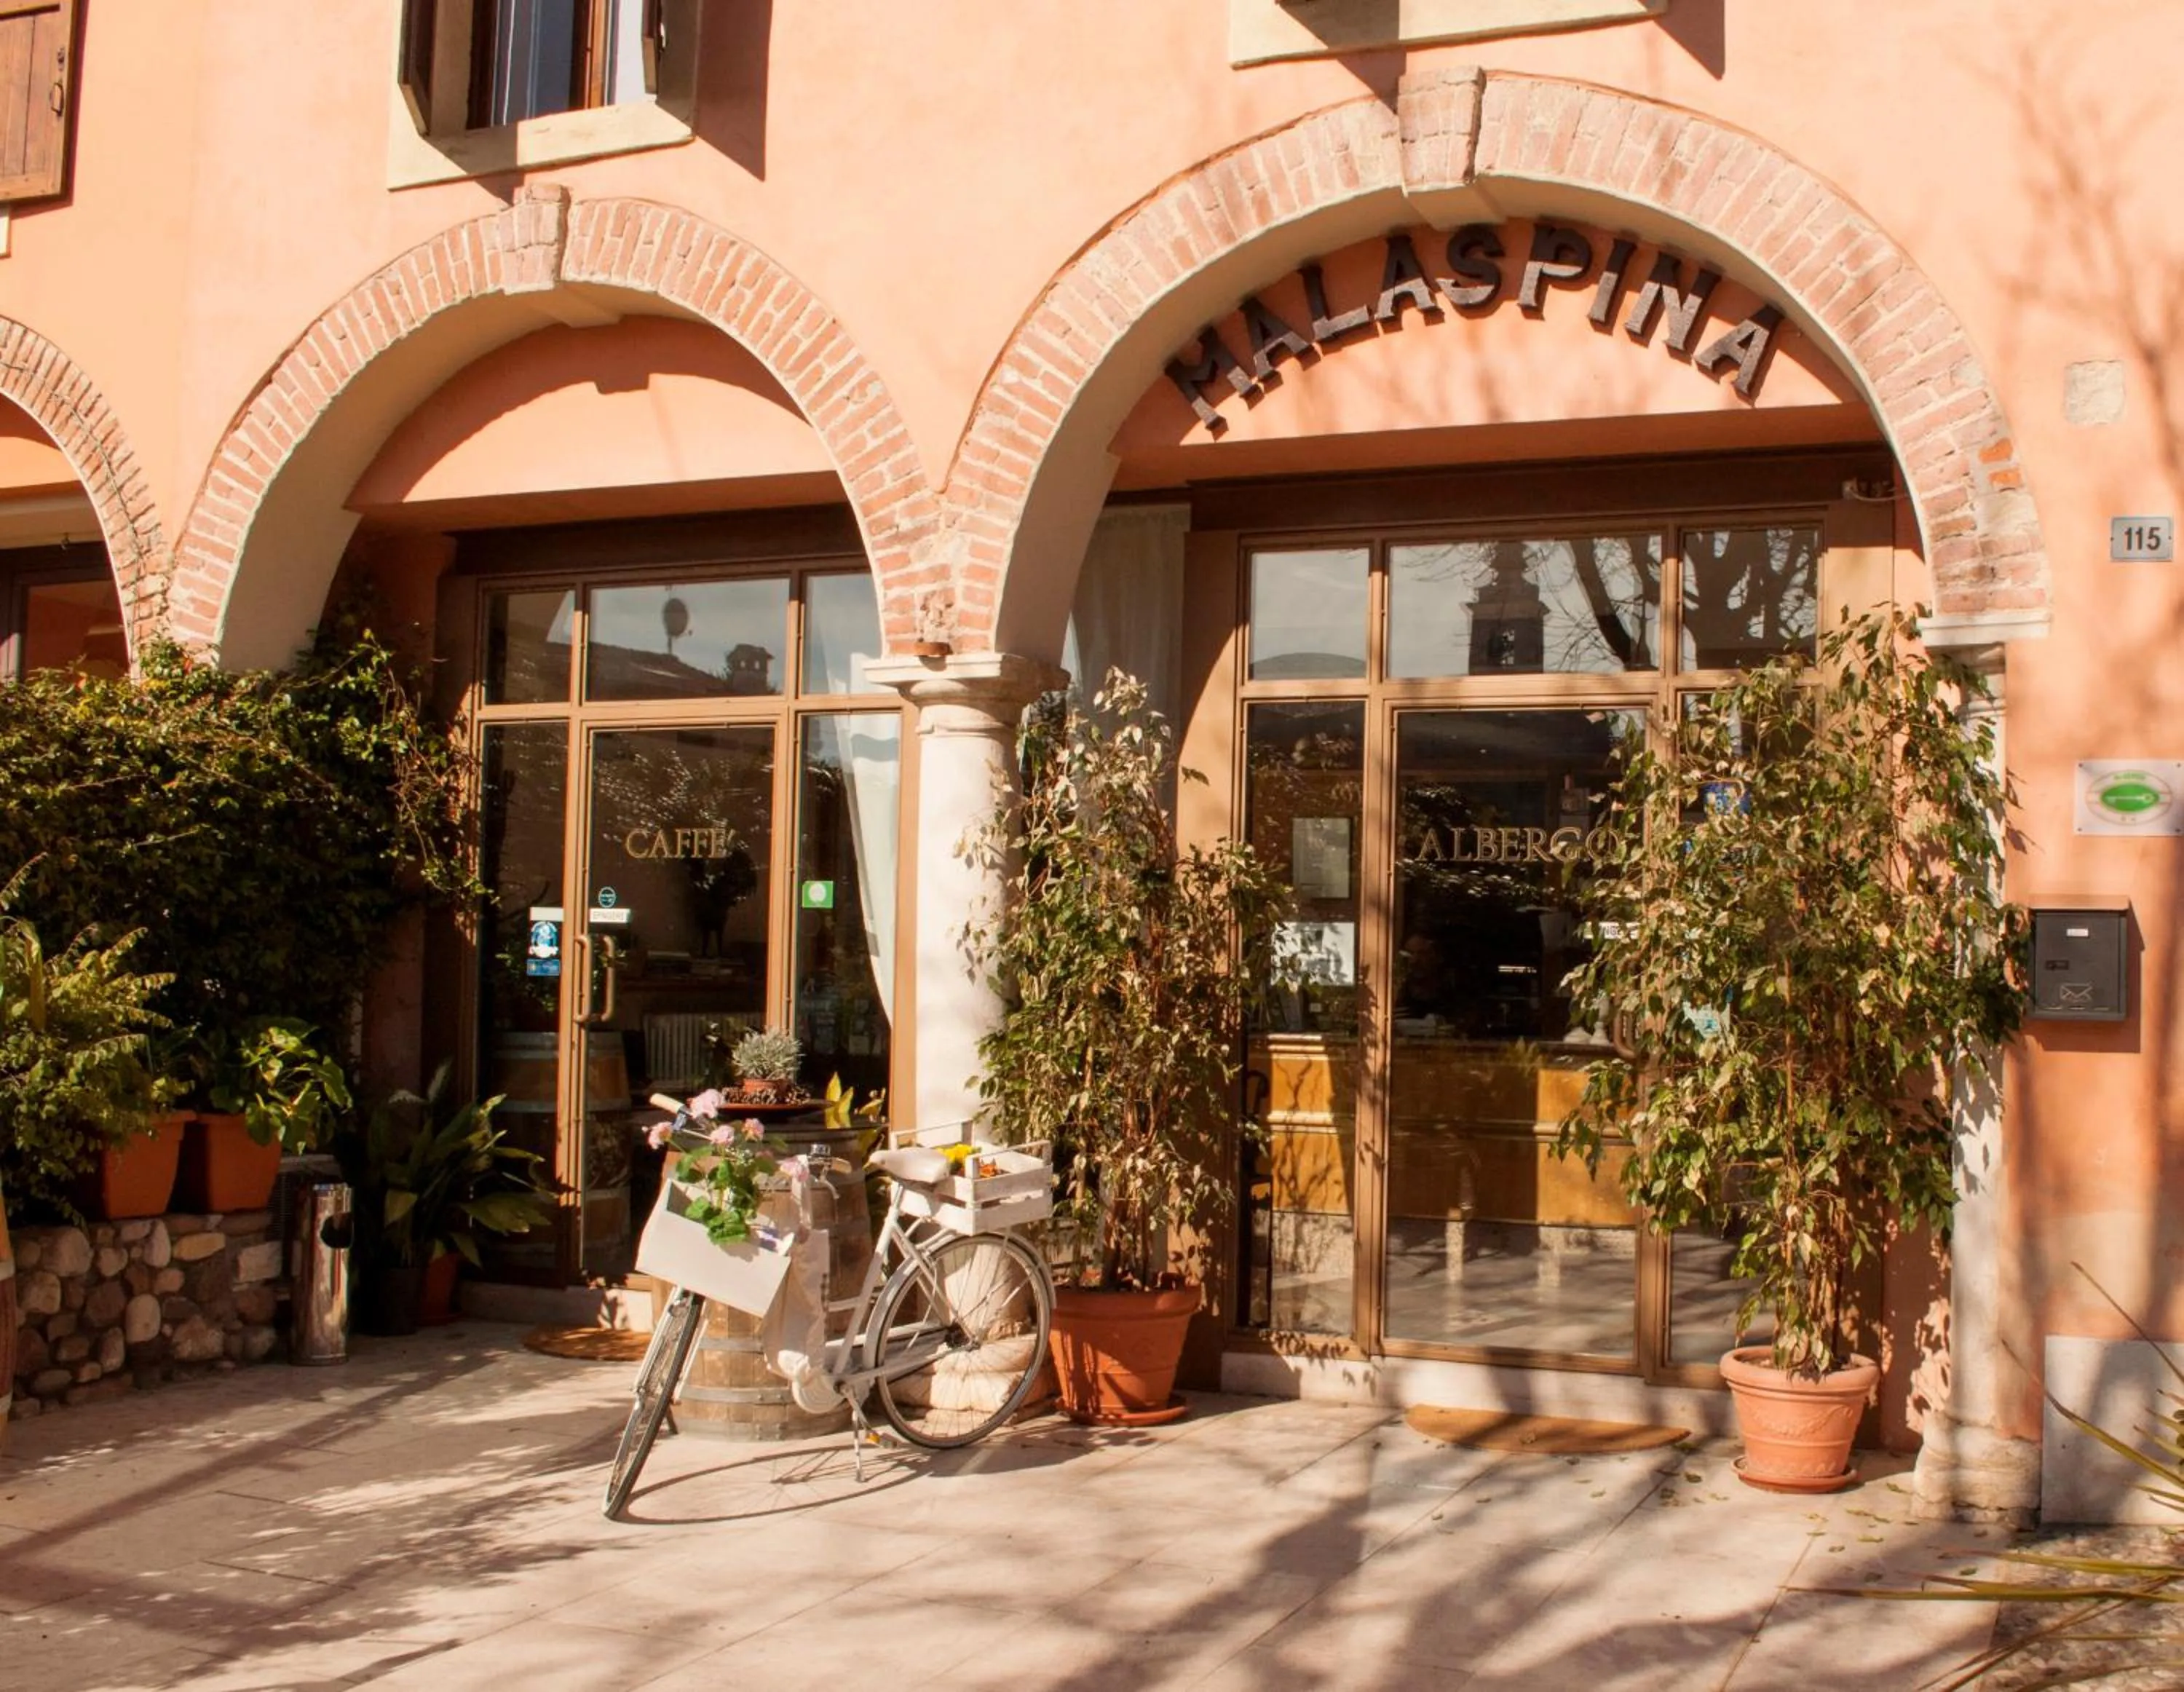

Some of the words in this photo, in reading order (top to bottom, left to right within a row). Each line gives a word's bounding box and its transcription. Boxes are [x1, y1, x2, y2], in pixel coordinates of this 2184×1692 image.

[1165, 224, 1784, 431] MALASPINA
[2124, 526, 2161, 551] 115
[1415, 826, 1620, 862] ALBERGO
